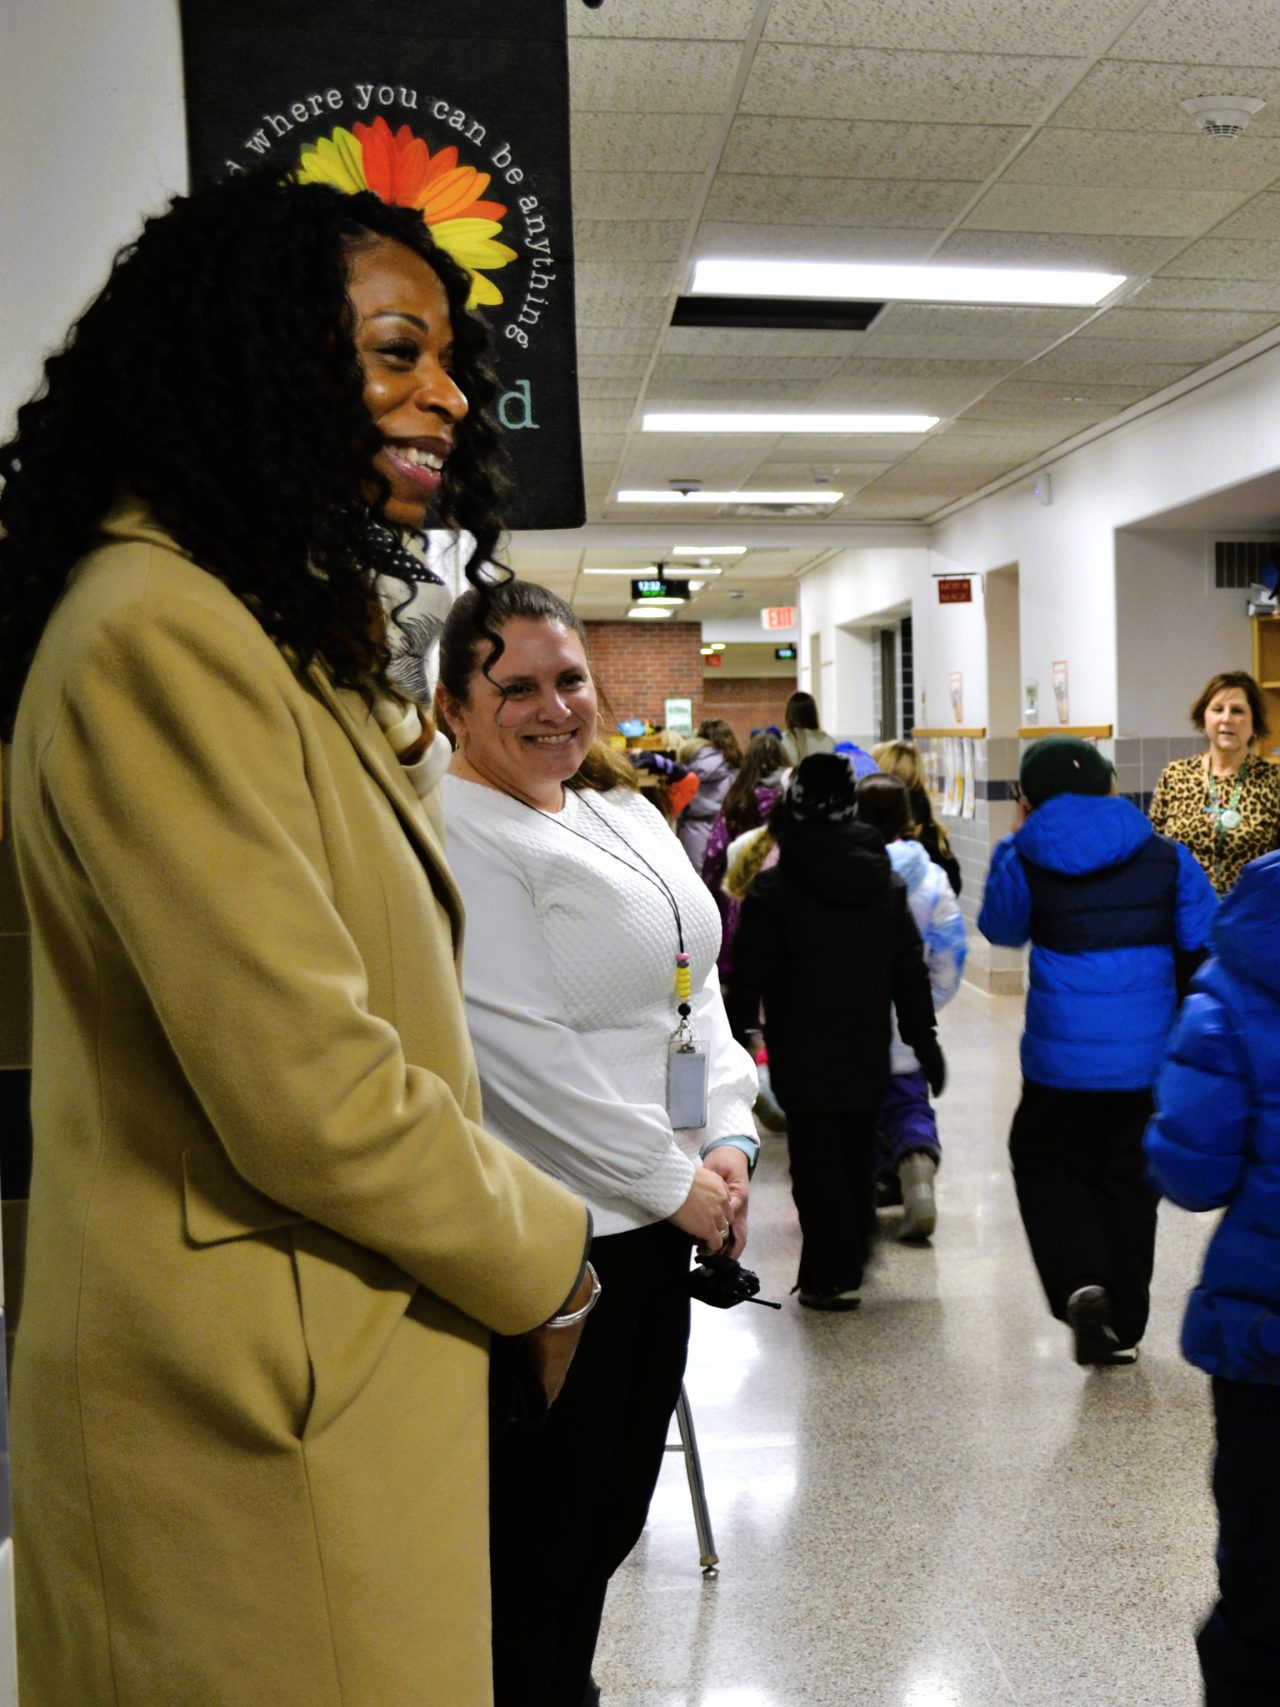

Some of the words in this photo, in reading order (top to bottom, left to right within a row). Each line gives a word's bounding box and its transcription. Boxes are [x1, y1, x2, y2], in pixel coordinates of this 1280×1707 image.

[355, 84, 418, 110] you
[245, 89, 344, 154] where
[432, 100, 487, 147] can
[491, 142, 524, 184] be
[504, 195, 557, 349] anything
[768, 606, 794, 628] EXIT
